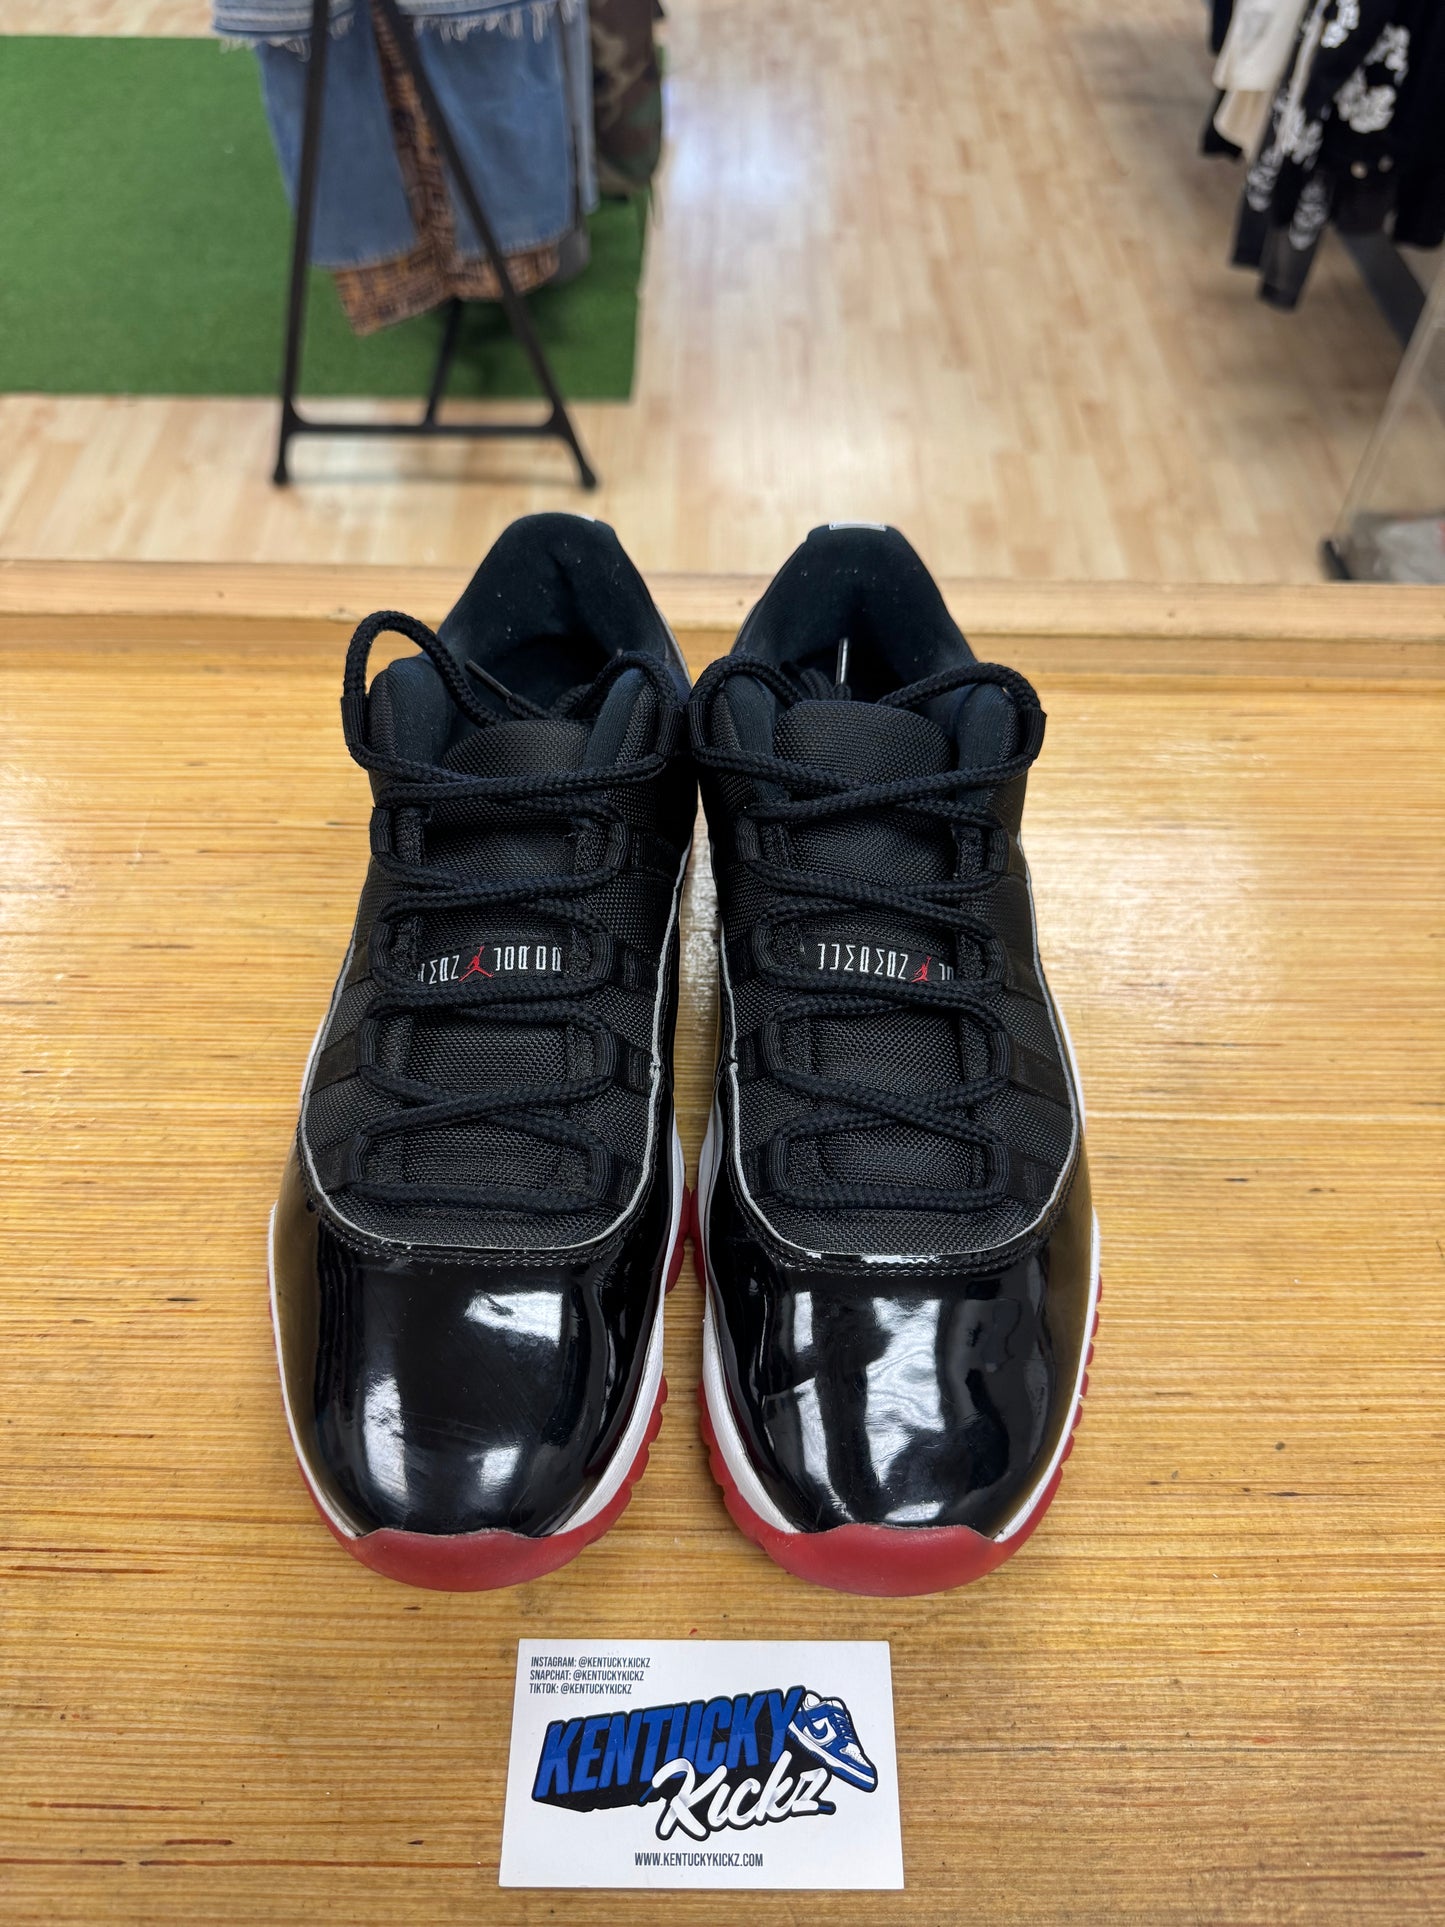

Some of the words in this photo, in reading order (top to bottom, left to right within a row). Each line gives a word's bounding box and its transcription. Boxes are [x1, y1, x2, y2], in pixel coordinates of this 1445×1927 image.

[531, 1656, 576, 1668] INSTAGRAM:
[578, 1656, 651, 1668] @KENTUCKY.KICKZ
[530, 1669, 571, 1681] SNAPCHAT:
[573, 1670, 644, 1682] @KENTUCKYKICKZ
[529, 1683, 559, 1694] TIKTOK:
[561, 1683, 632, 1695] @KENTUCKYKICKZ
[533, 1687, 805, 1798] KENTUCKY
[651, 1750, 827, 1837] Kickz
[634, 1852, 764, 1867] WWW.KENTUCKYKICKZ.COM
